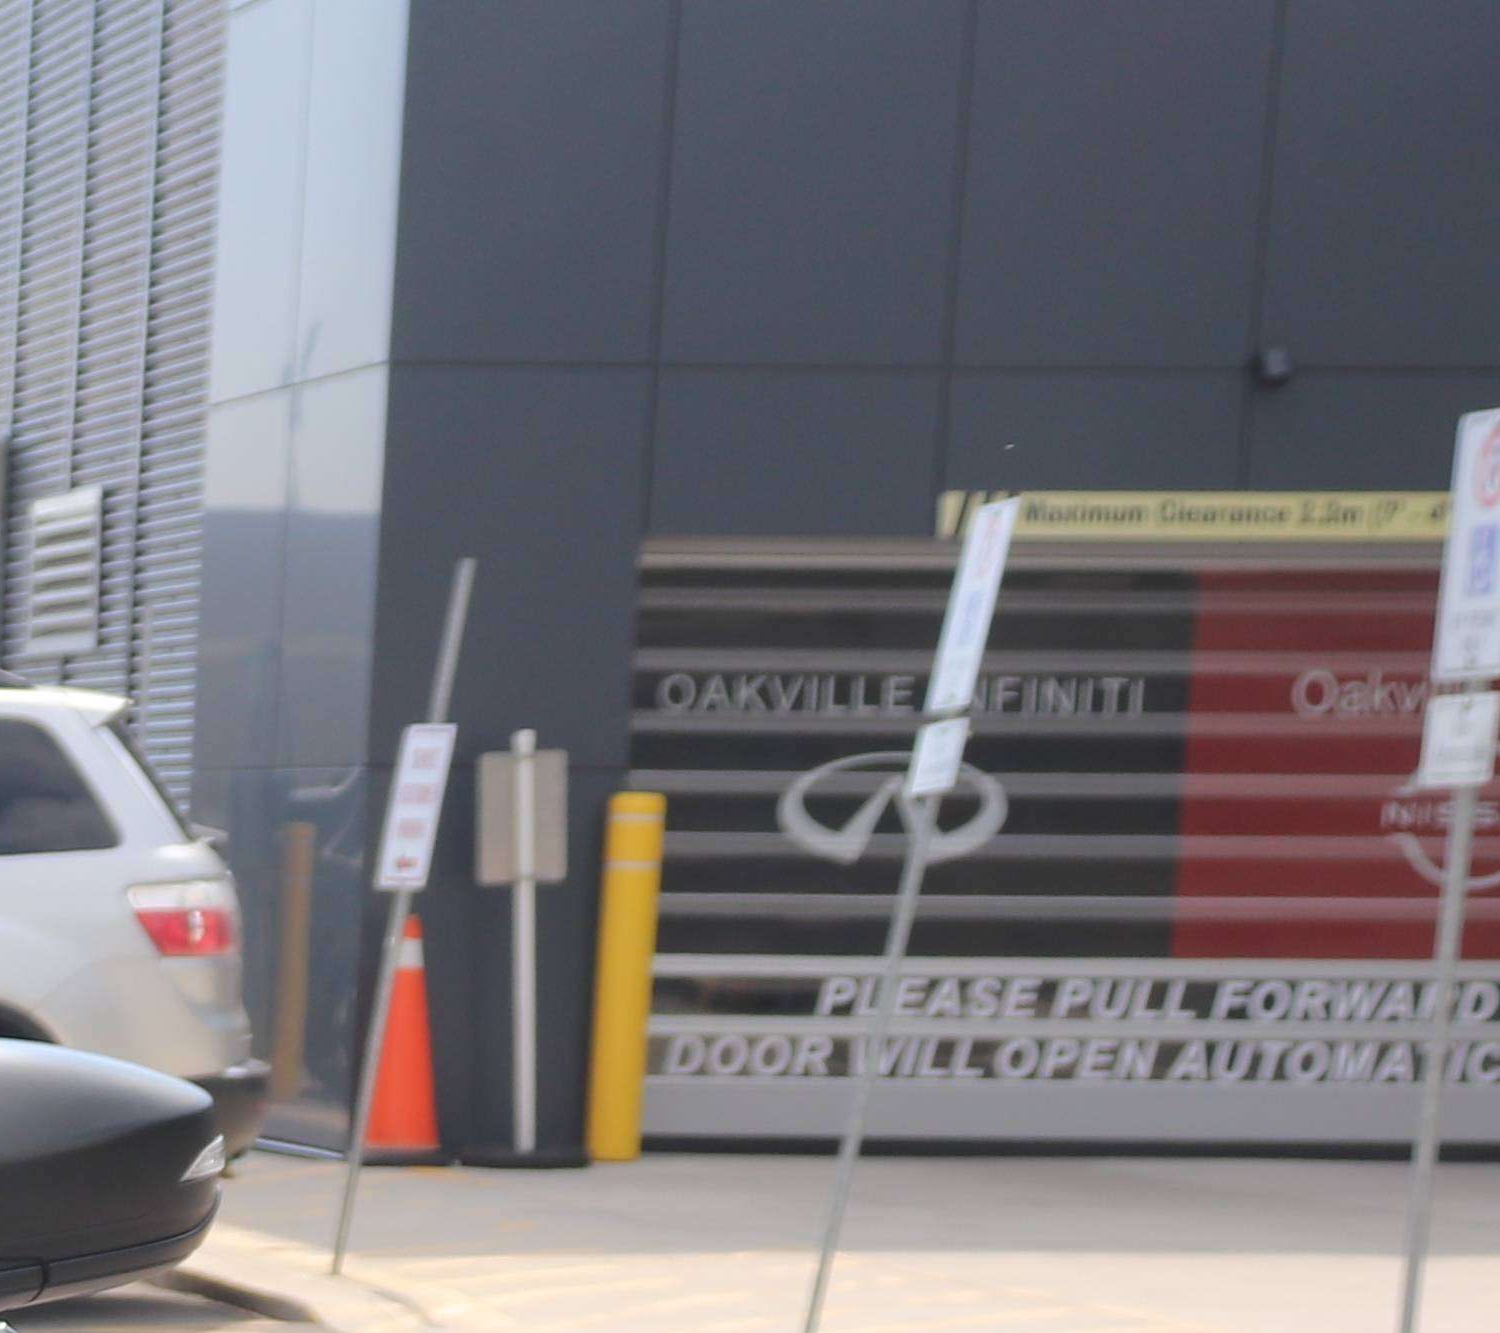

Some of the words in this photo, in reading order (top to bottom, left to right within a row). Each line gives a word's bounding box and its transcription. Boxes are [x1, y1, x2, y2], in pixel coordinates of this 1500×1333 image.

[1024, 499, 1145, 525] Maximum
[1158, 498, 1289, 526] Clearance
[655, 673, 914, 715] OAKVILLE
[1292, 670, 1429, 719] Oakv
[818, 977, 1041, 1018] PLEASE
[1056, 978, 1198, 1021] PULL
[668, 1034, 834, 1077] DOOR
[994, 1037, 1160, 1079] OPEN
